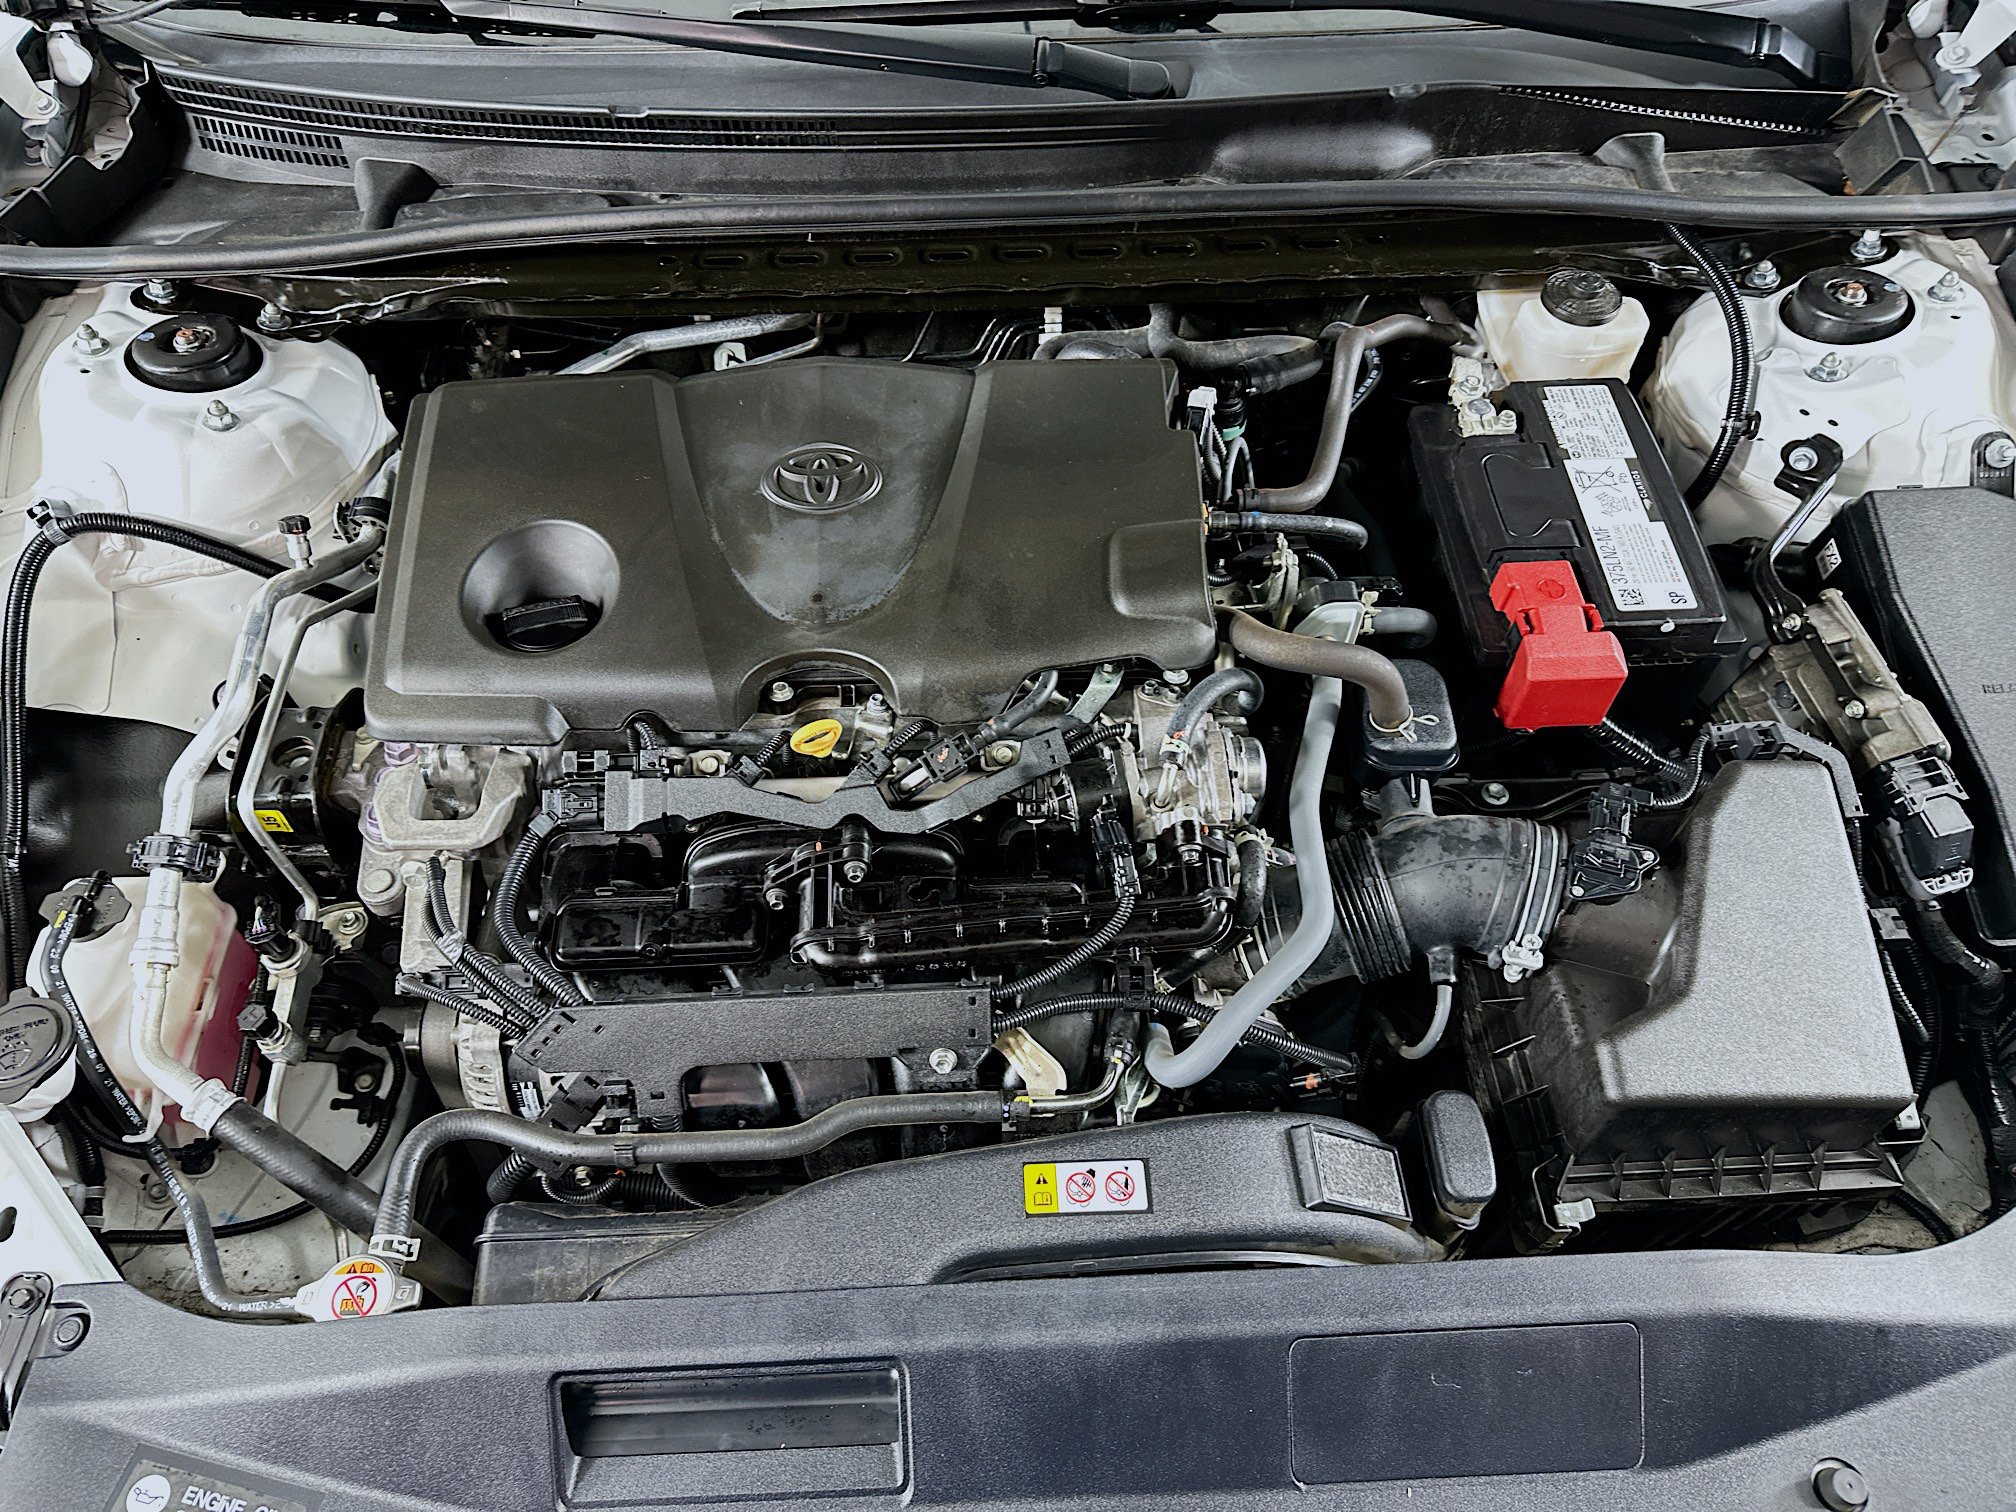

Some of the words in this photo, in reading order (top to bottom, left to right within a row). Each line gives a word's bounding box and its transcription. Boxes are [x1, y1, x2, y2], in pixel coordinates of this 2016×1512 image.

[1619, 472, 1629, 484] Pb
[1631, 470, 1649, 498] CLARIOS
[1592, 526, 1628, 584] 375LN2-MF
[1668, 591, 1688, 604] SP
[55, 980, 66, 990] 21
[104, 1078, 114, 1088] 21
[111, 1087, 128, 1109] WATER
[221, 1301, 233, 1311] 21
[239, 1301, 268, 1312] WATER
[181, 1485, 247, 1512] ENGINE
